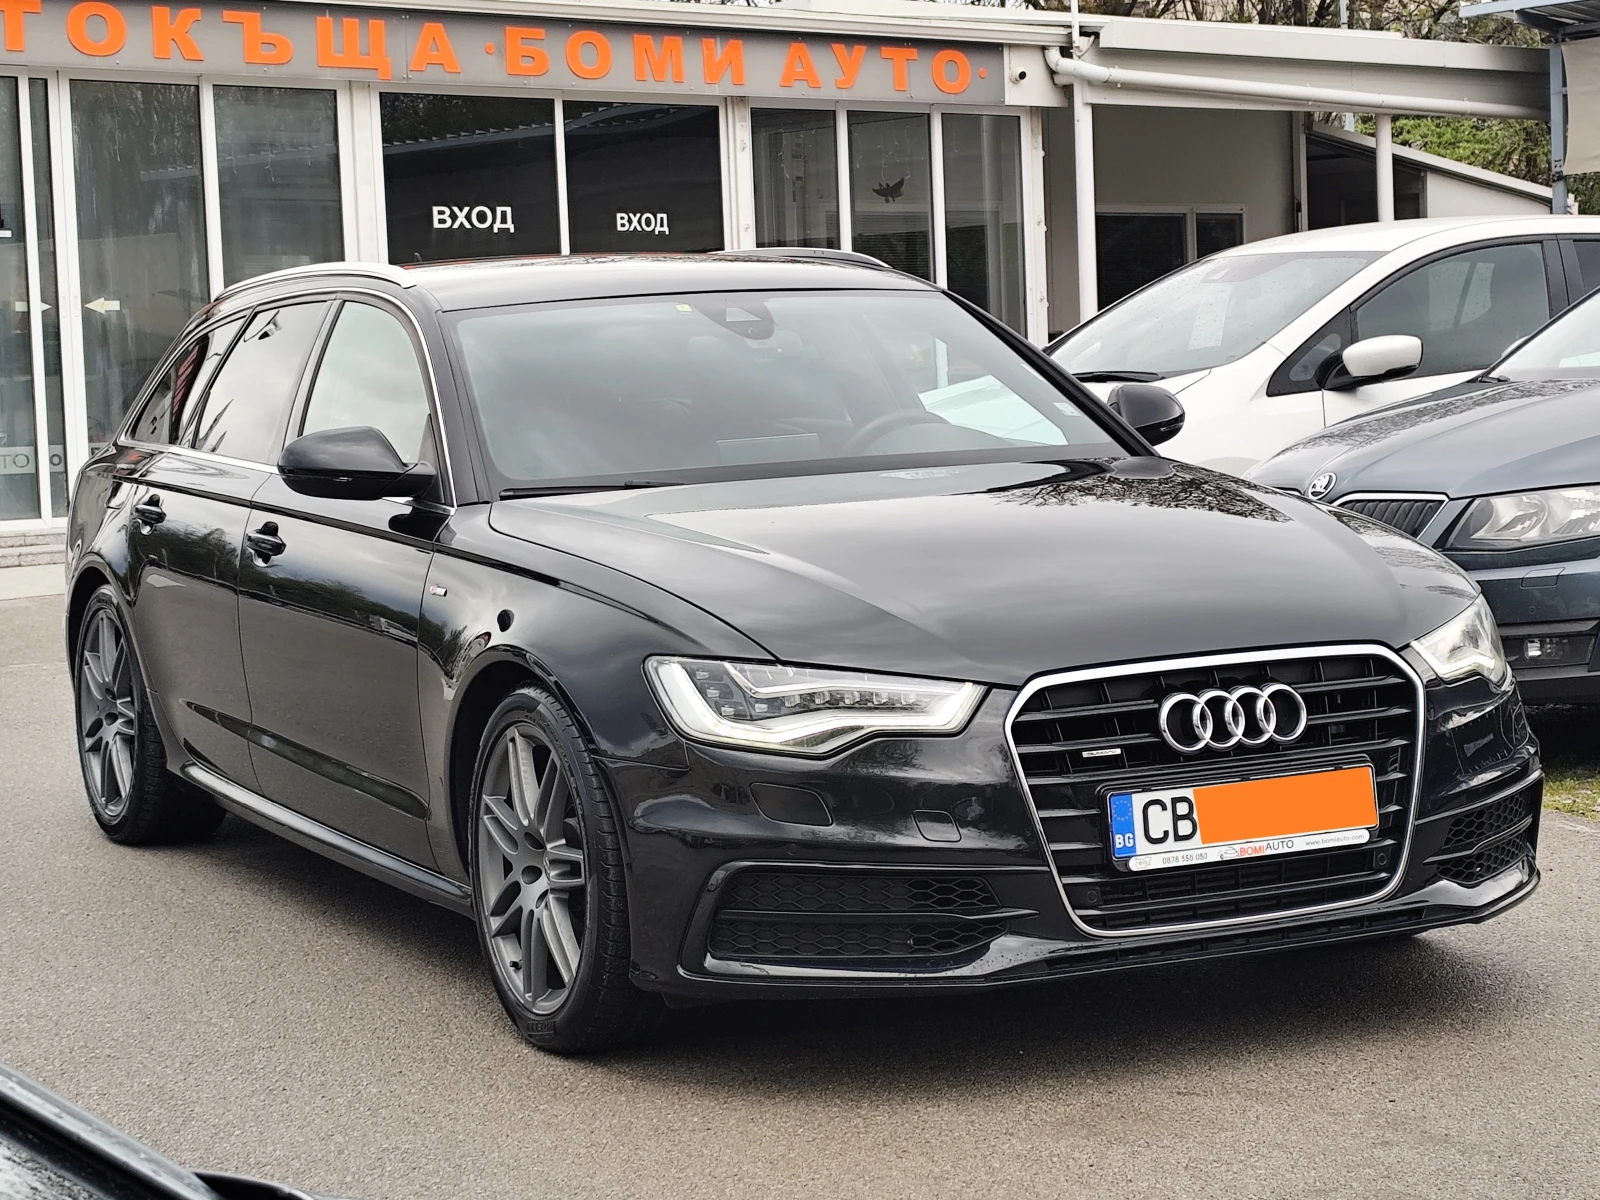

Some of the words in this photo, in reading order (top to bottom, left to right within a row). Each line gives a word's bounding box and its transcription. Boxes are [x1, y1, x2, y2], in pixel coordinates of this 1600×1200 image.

[504, 26, 745, 86] БОМИ
[780, 43, 971, 94] АУТО
[432, 205, 514, 233] ВХОД
[616, 212, 669, 235] ВХОД
[1142, 796, 1198, 845] CB
[1114, 832, 1135, 849] BG
[1305, 833, 1365, 847] www.bomiauto.com
